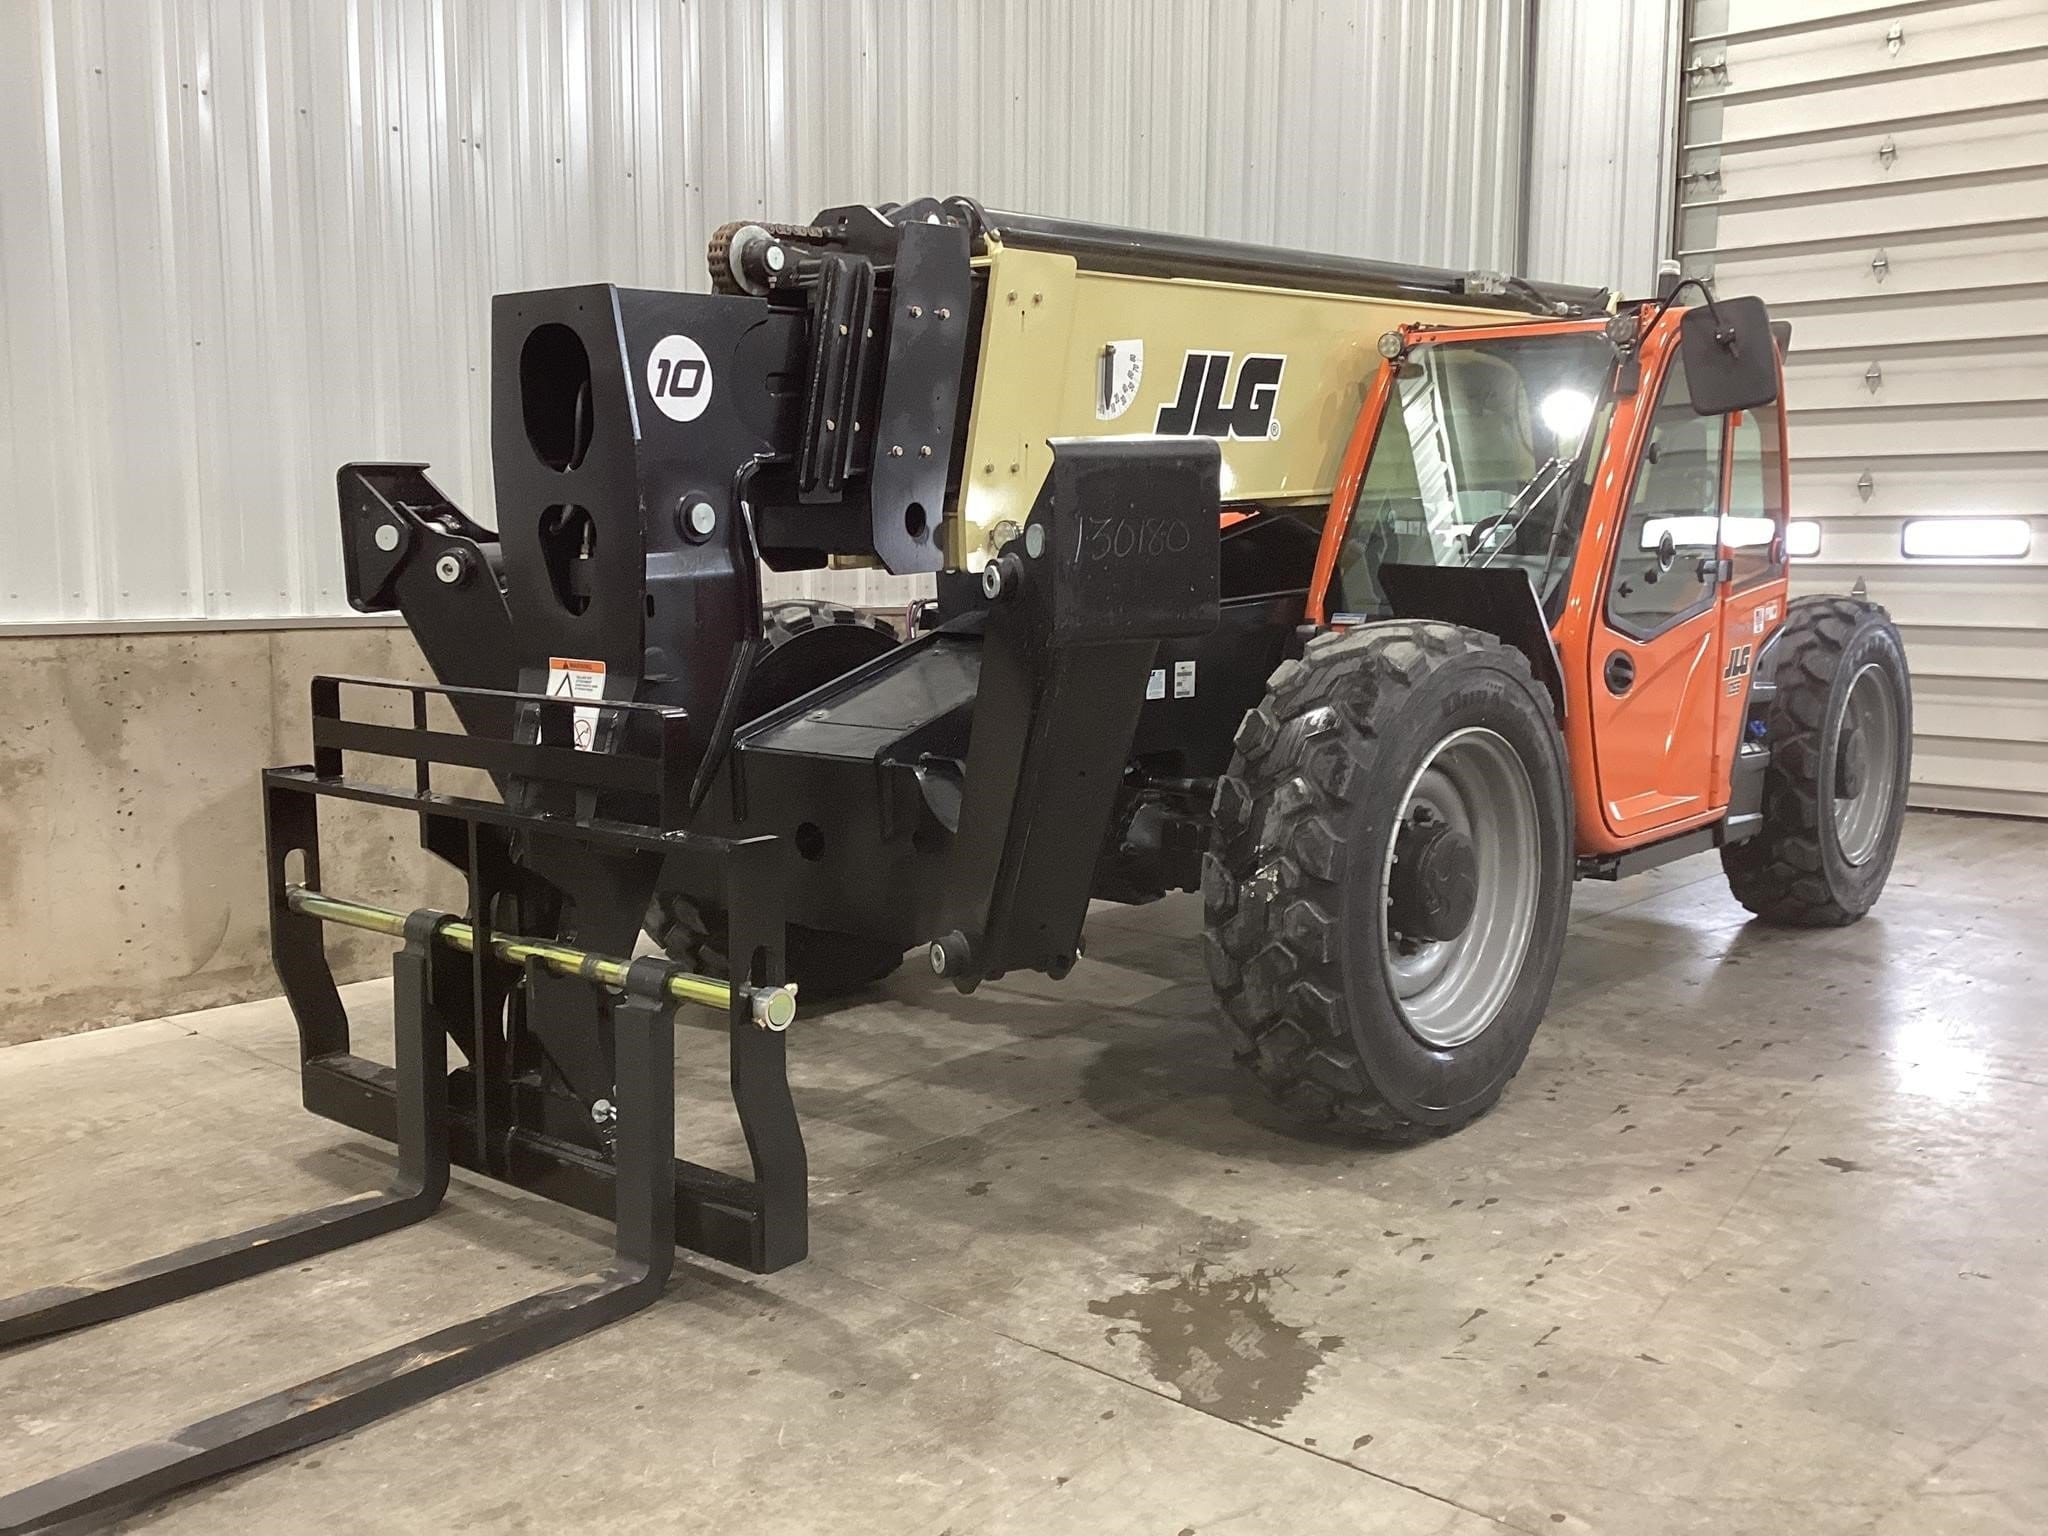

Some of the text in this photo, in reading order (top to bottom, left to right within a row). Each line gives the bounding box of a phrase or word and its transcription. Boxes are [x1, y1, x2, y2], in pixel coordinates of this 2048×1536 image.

[656, 358, 706, 397] 10
[1154, 353, 1285, 438] JLG
[1723, 646, 1751, 679] JLG
